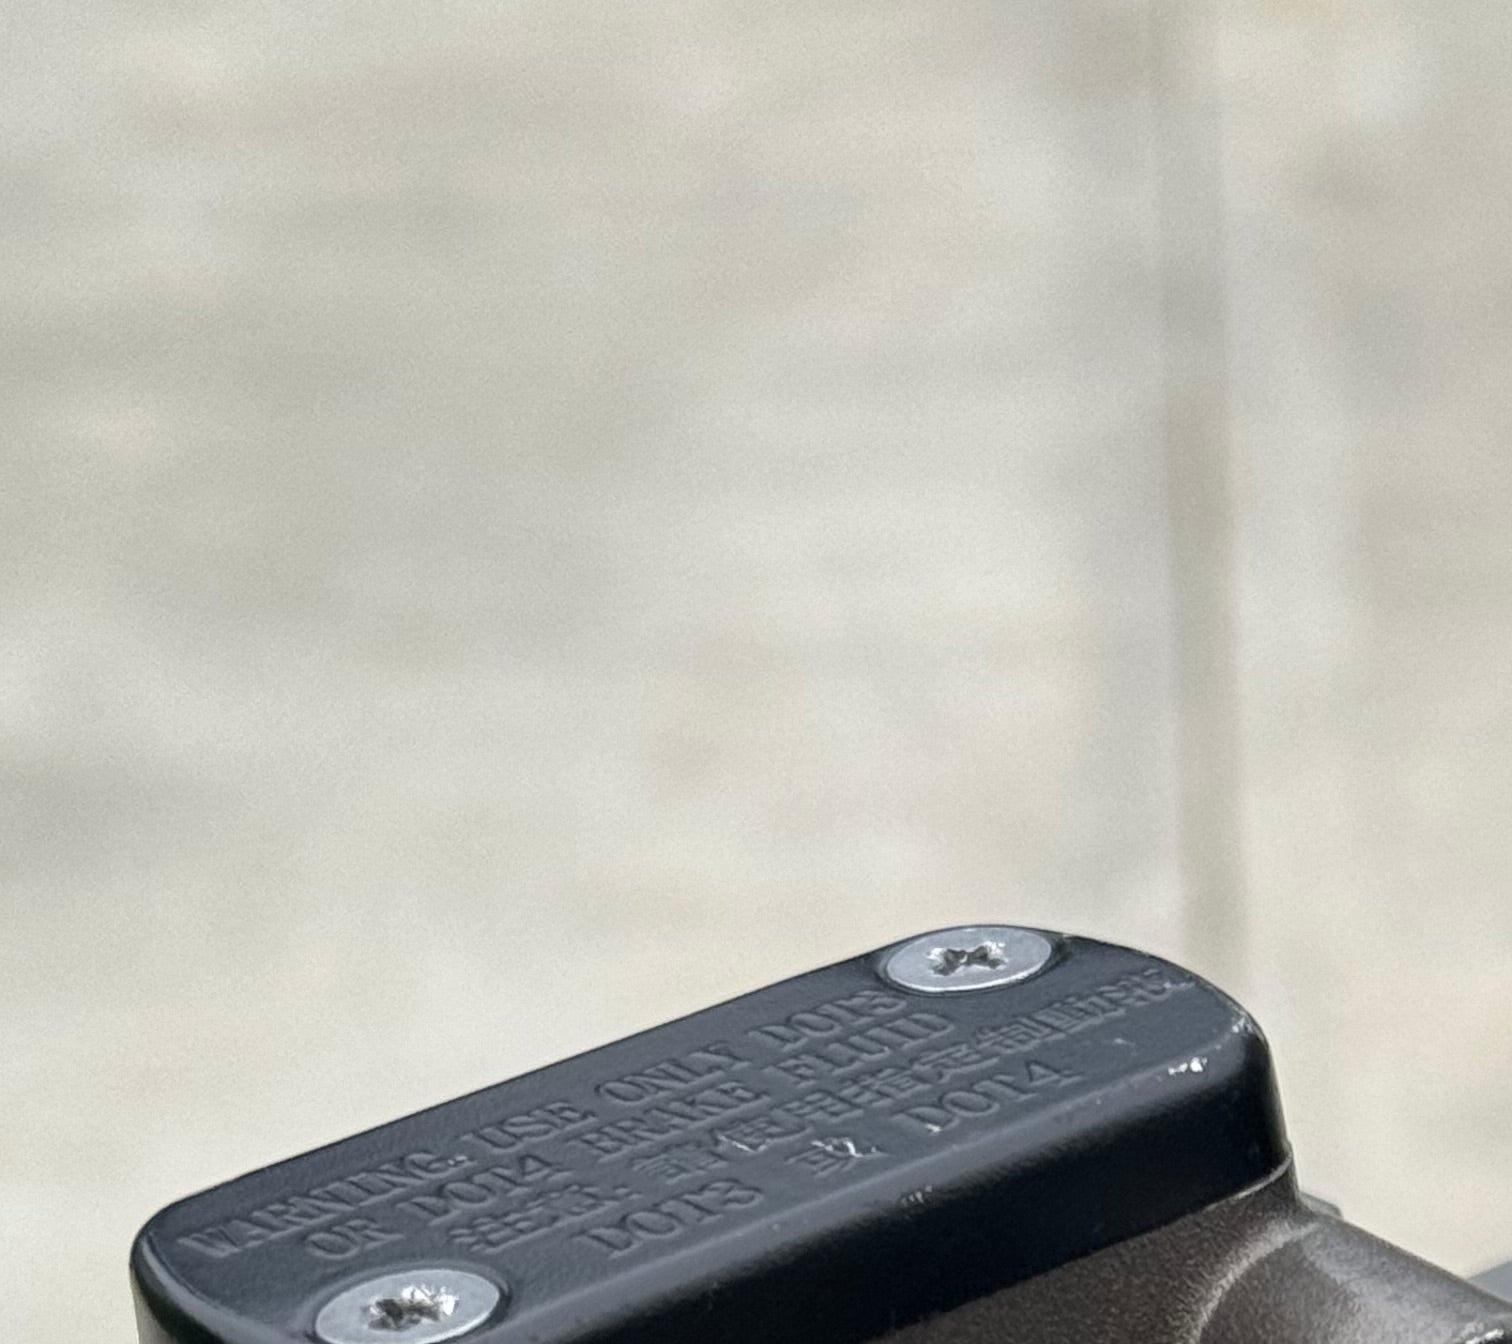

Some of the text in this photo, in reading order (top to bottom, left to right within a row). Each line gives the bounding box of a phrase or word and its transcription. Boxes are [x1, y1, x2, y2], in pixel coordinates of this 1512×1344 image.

[303, 1218, 403, 1260] OR
[567, 1081, 771, 1161] BRAKE
[765, 1010, 957, 1088] FLUID
[457, 1101, 598, 1155] USE
[594, 1042, 752, 1106] ONLY
